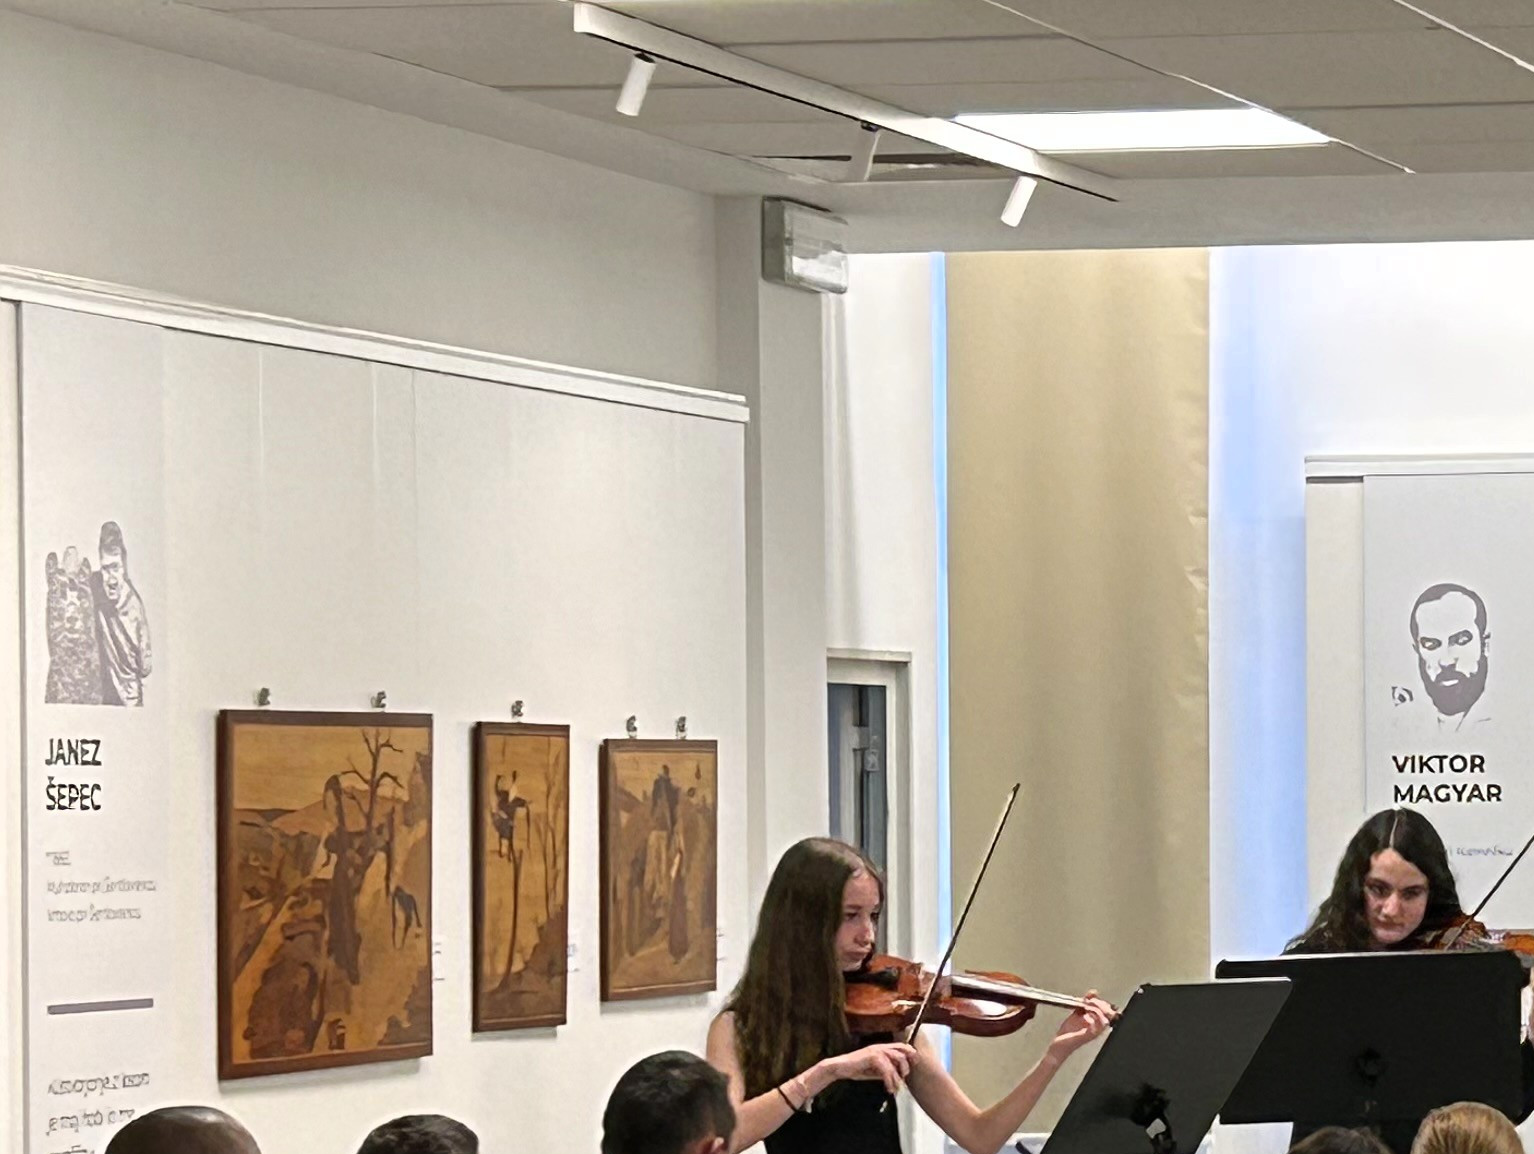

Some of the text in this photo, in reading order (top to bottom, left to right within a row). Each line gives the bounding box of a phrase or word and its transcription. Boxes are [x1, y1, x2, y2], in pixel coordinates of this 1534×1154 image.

[45, 738, 102, 766] JANEZ
[1391, 754, 1485, 774] VIKTOR
[45, 775, 102, 811] ŠEPEC
[1393, 783, 1502, 803] MAGYAR
